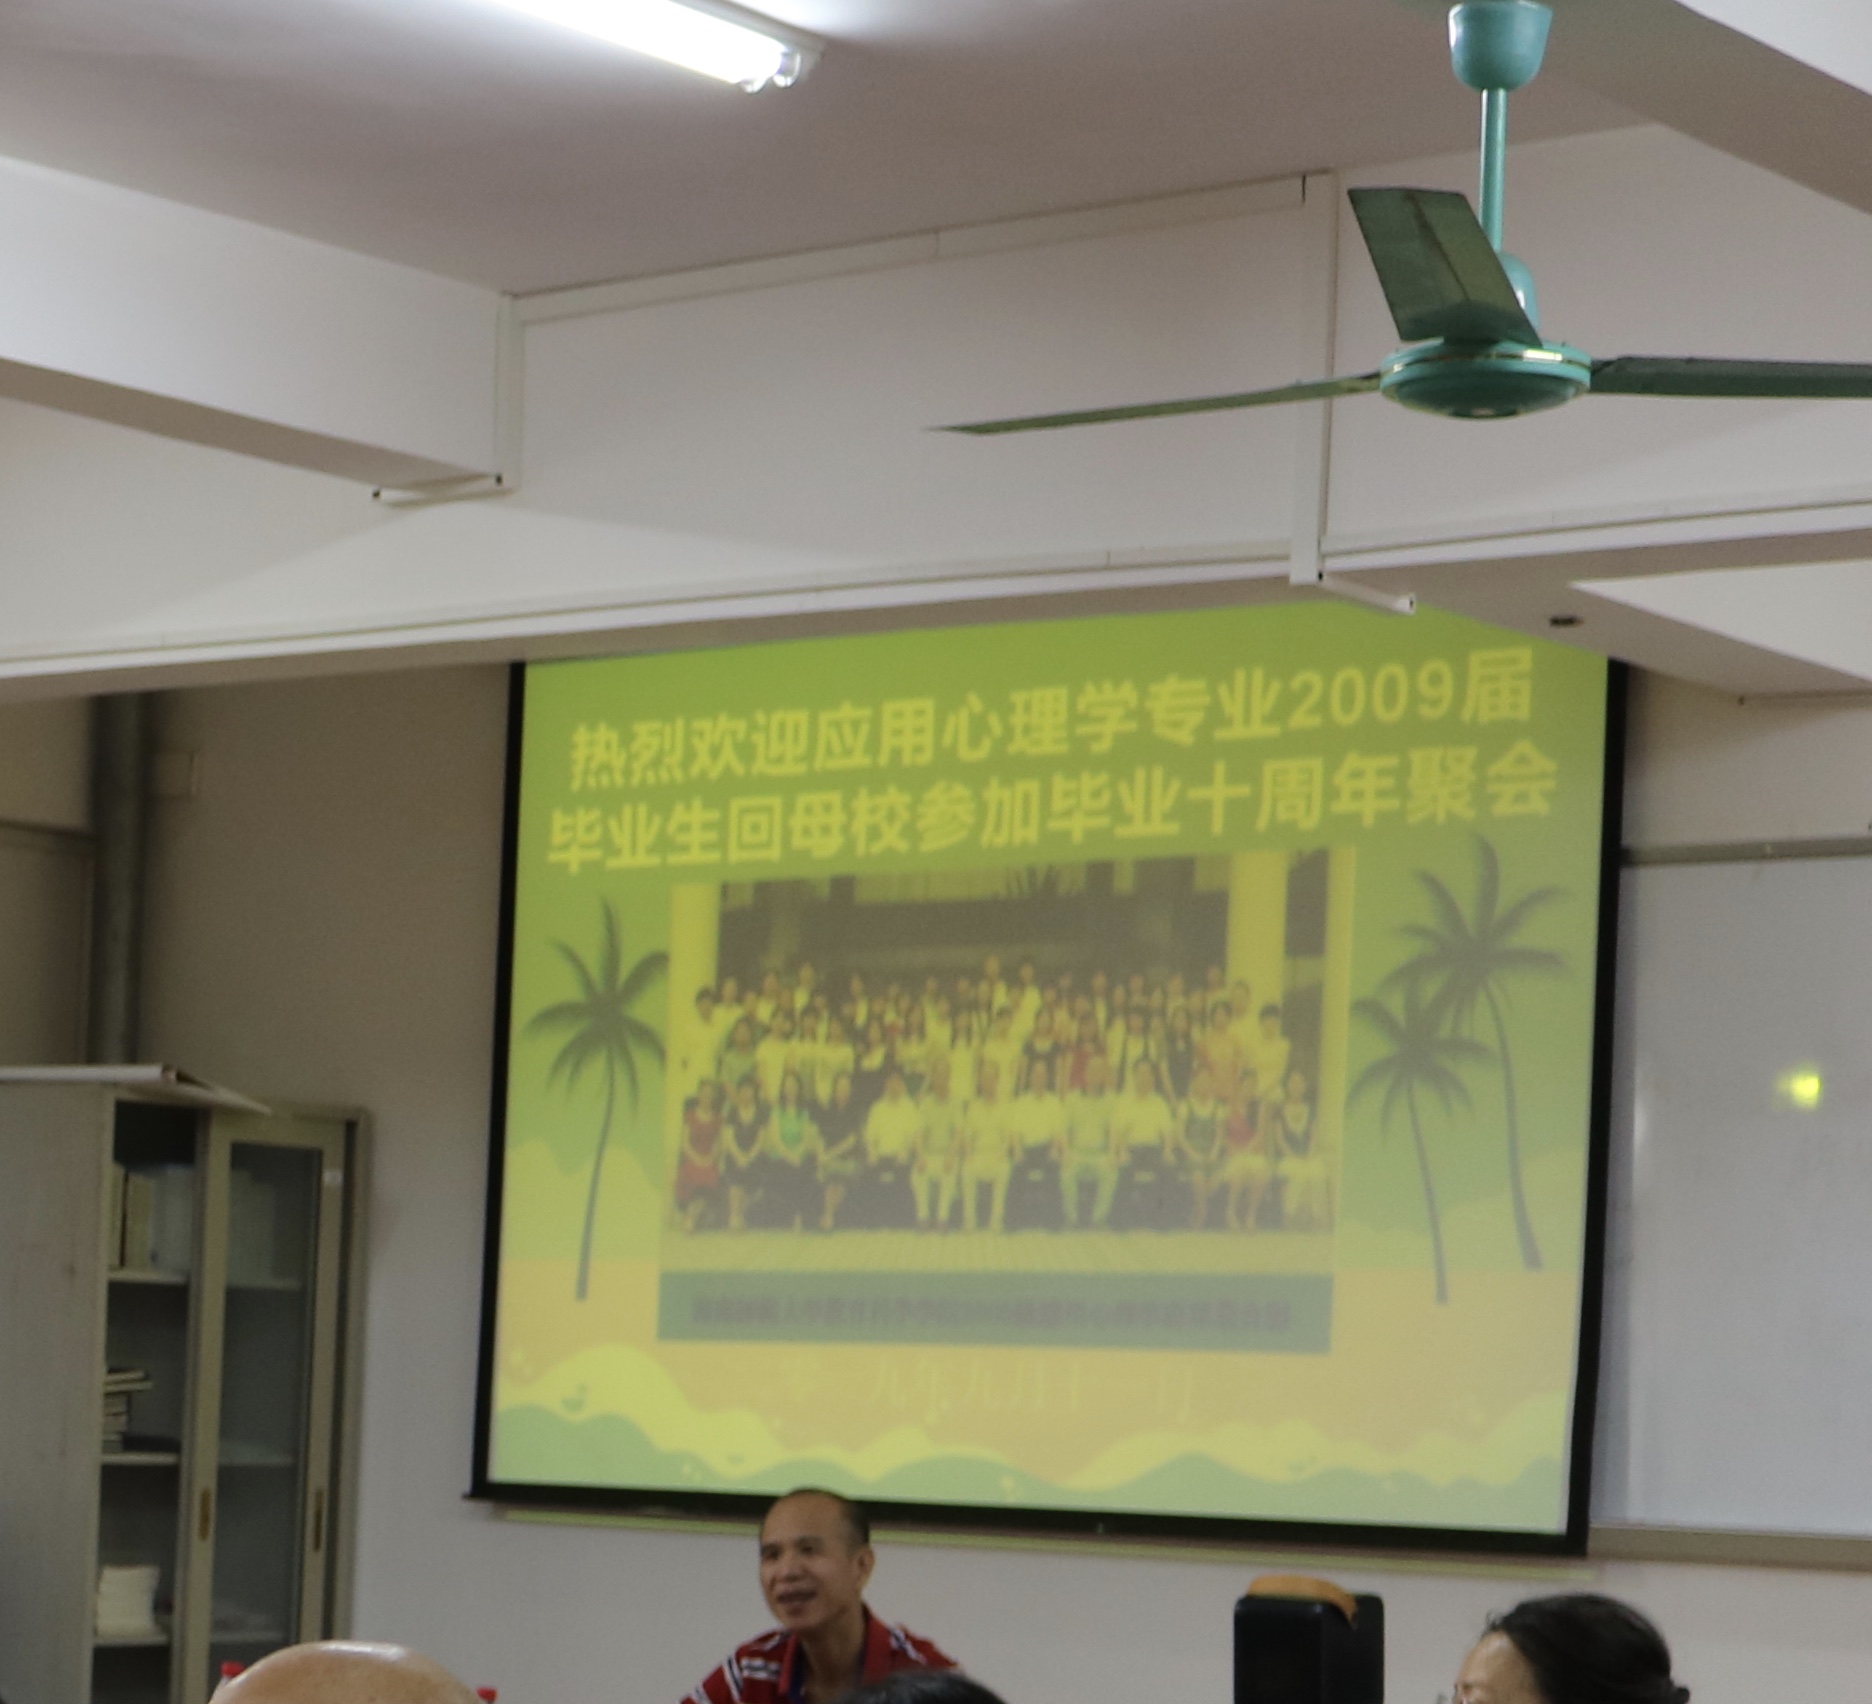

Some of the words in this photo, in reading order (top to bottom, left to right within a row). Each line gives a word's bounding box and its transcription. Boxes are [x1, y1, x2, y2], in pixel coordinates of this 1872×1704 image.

[569, 647, 1533, 792] 热烈欢迎应用心理学专业2009届
[547, 739, 1559, 875] 毕业生回母校参加毕业十周年聚会
